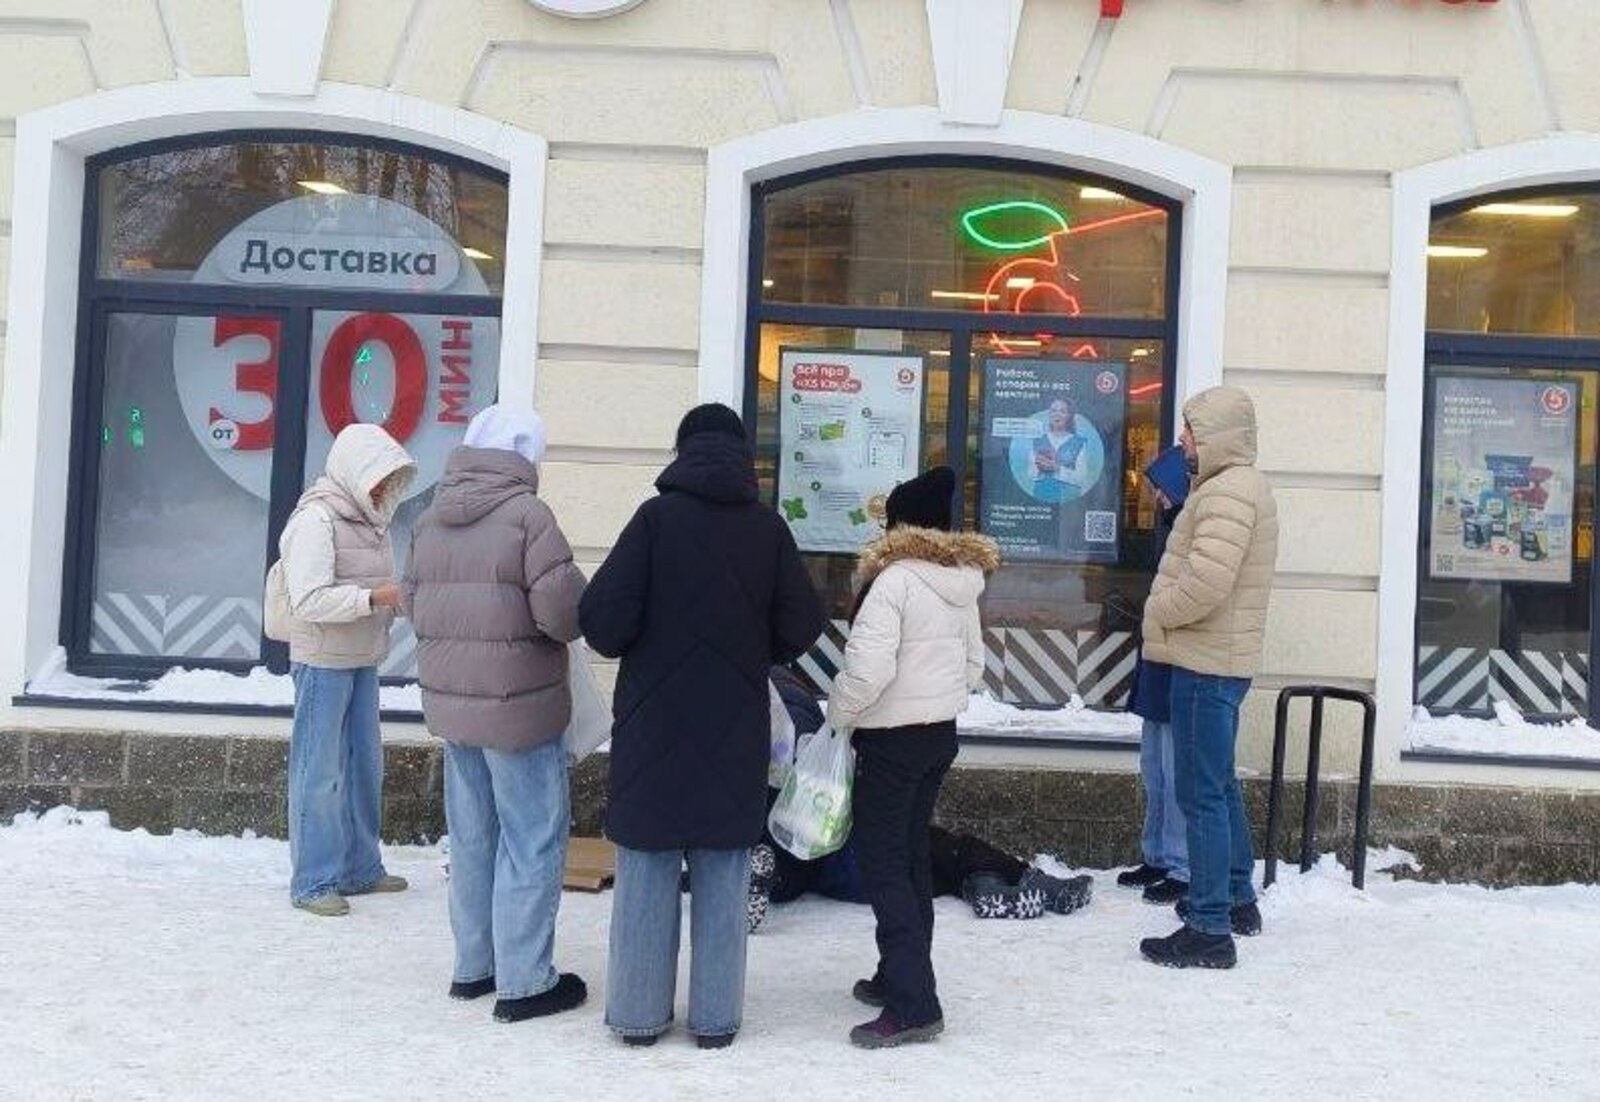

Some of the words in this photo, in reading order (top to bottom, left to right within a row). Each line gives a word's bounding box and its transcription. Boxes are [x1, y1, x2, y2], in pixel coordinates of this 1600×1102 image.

[239, 239, 437, 276] Доставка
[209, 312, 428, 451] 30
[212, 428, 234, 440] от
